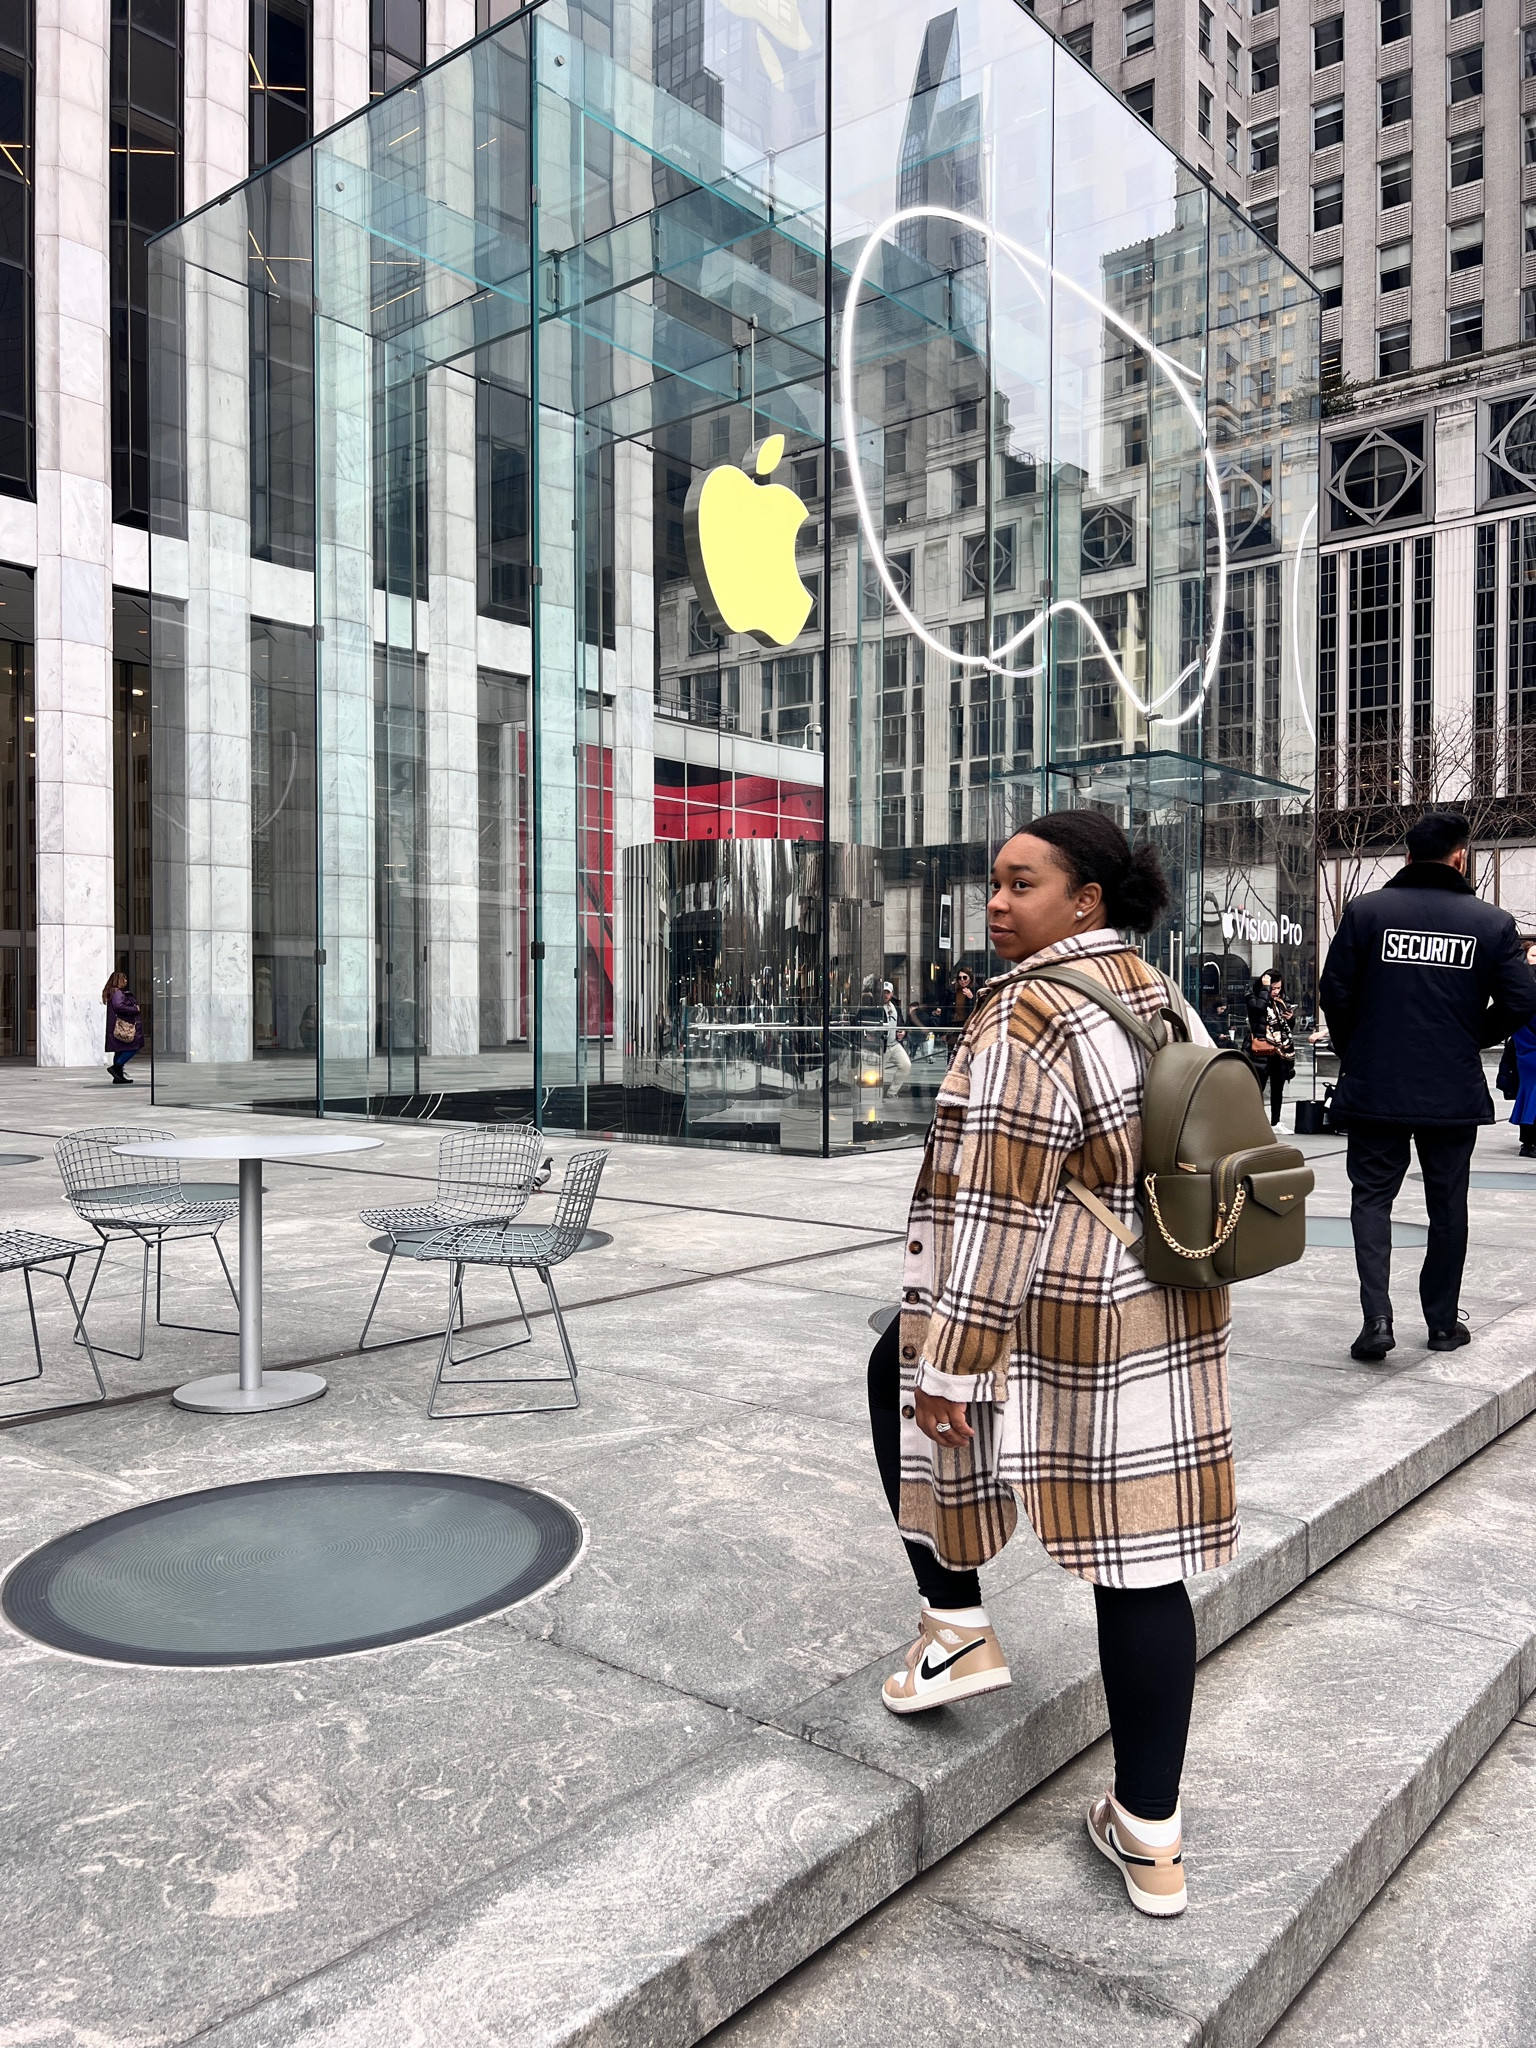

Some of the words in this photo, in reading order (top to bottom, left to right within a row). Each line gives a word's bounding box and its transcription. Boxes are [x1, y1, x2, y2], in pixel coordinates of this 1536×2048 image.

[1235, 908, 1278, 943] Vision
[1280, 914, 1303, 946] Pro
[1386, 933, 1473, 964] SECURITY
